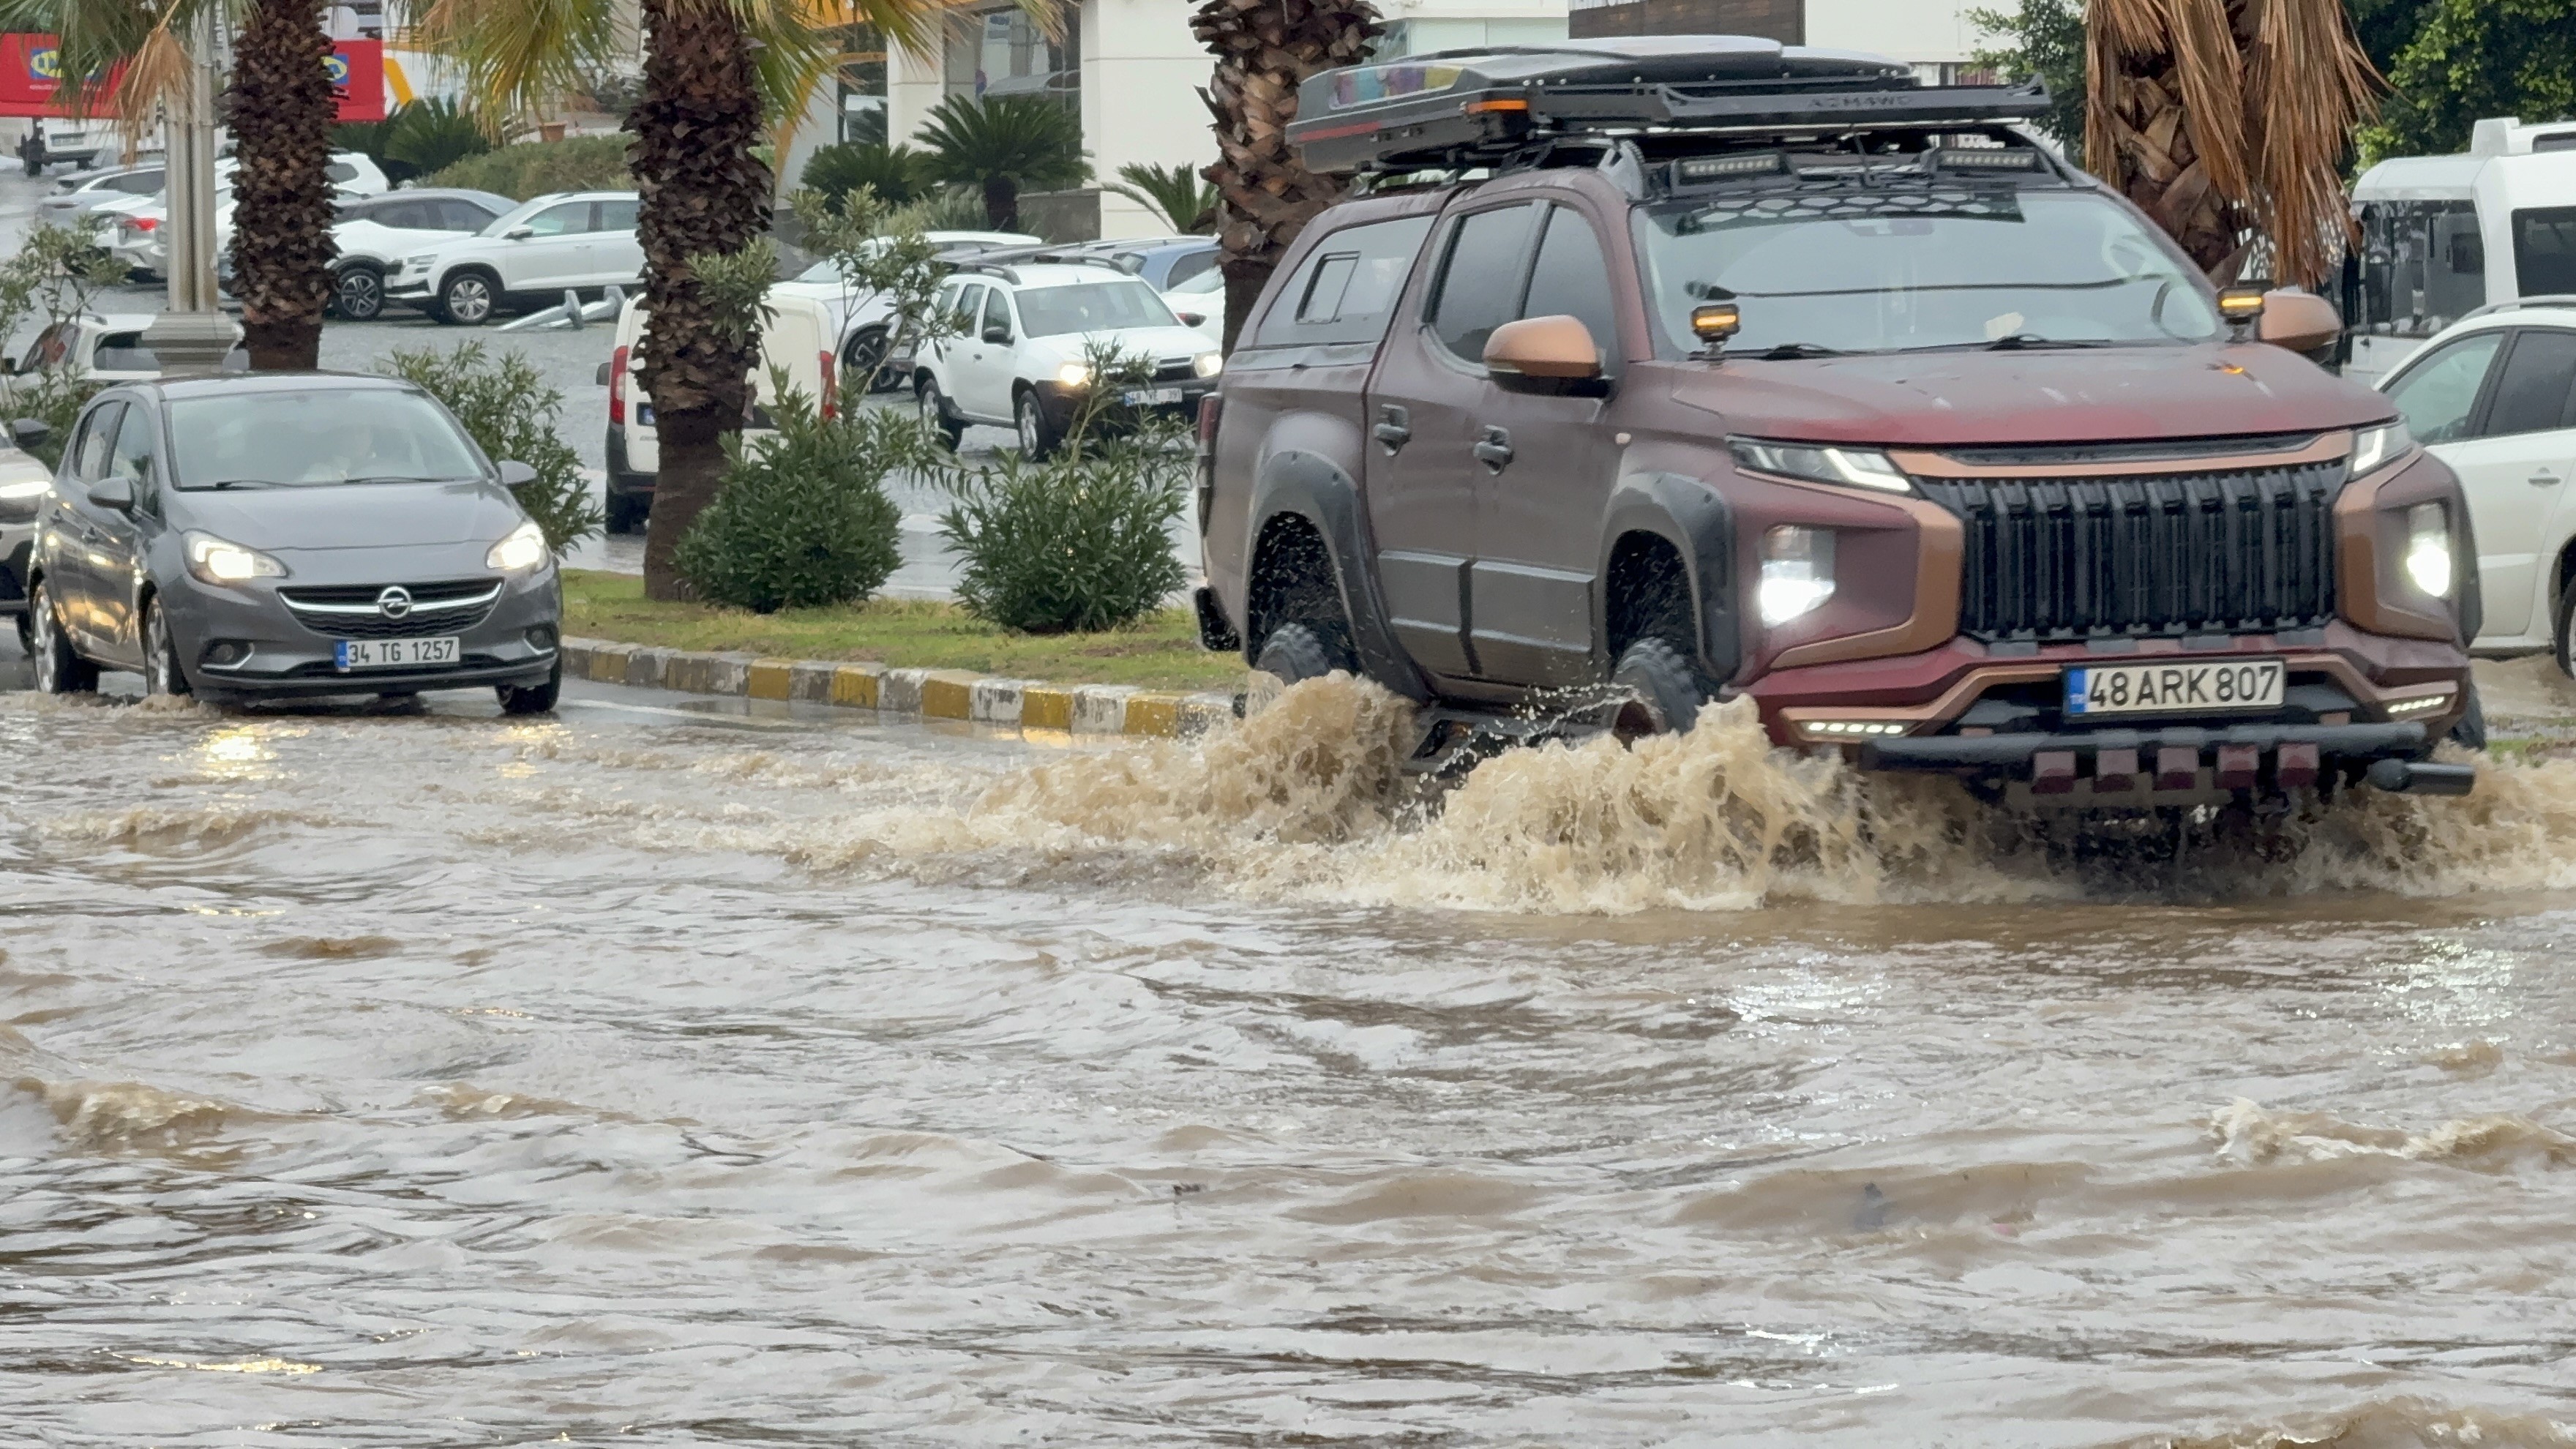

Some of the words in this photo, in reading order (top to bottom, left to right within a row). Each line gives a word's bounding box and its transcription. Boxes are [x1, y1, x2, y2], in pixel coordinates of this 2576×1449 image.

[348, 643, 370, 664] 34
[379, 643, 402, 662] TG
[411, 640, 454, 661] 1257
